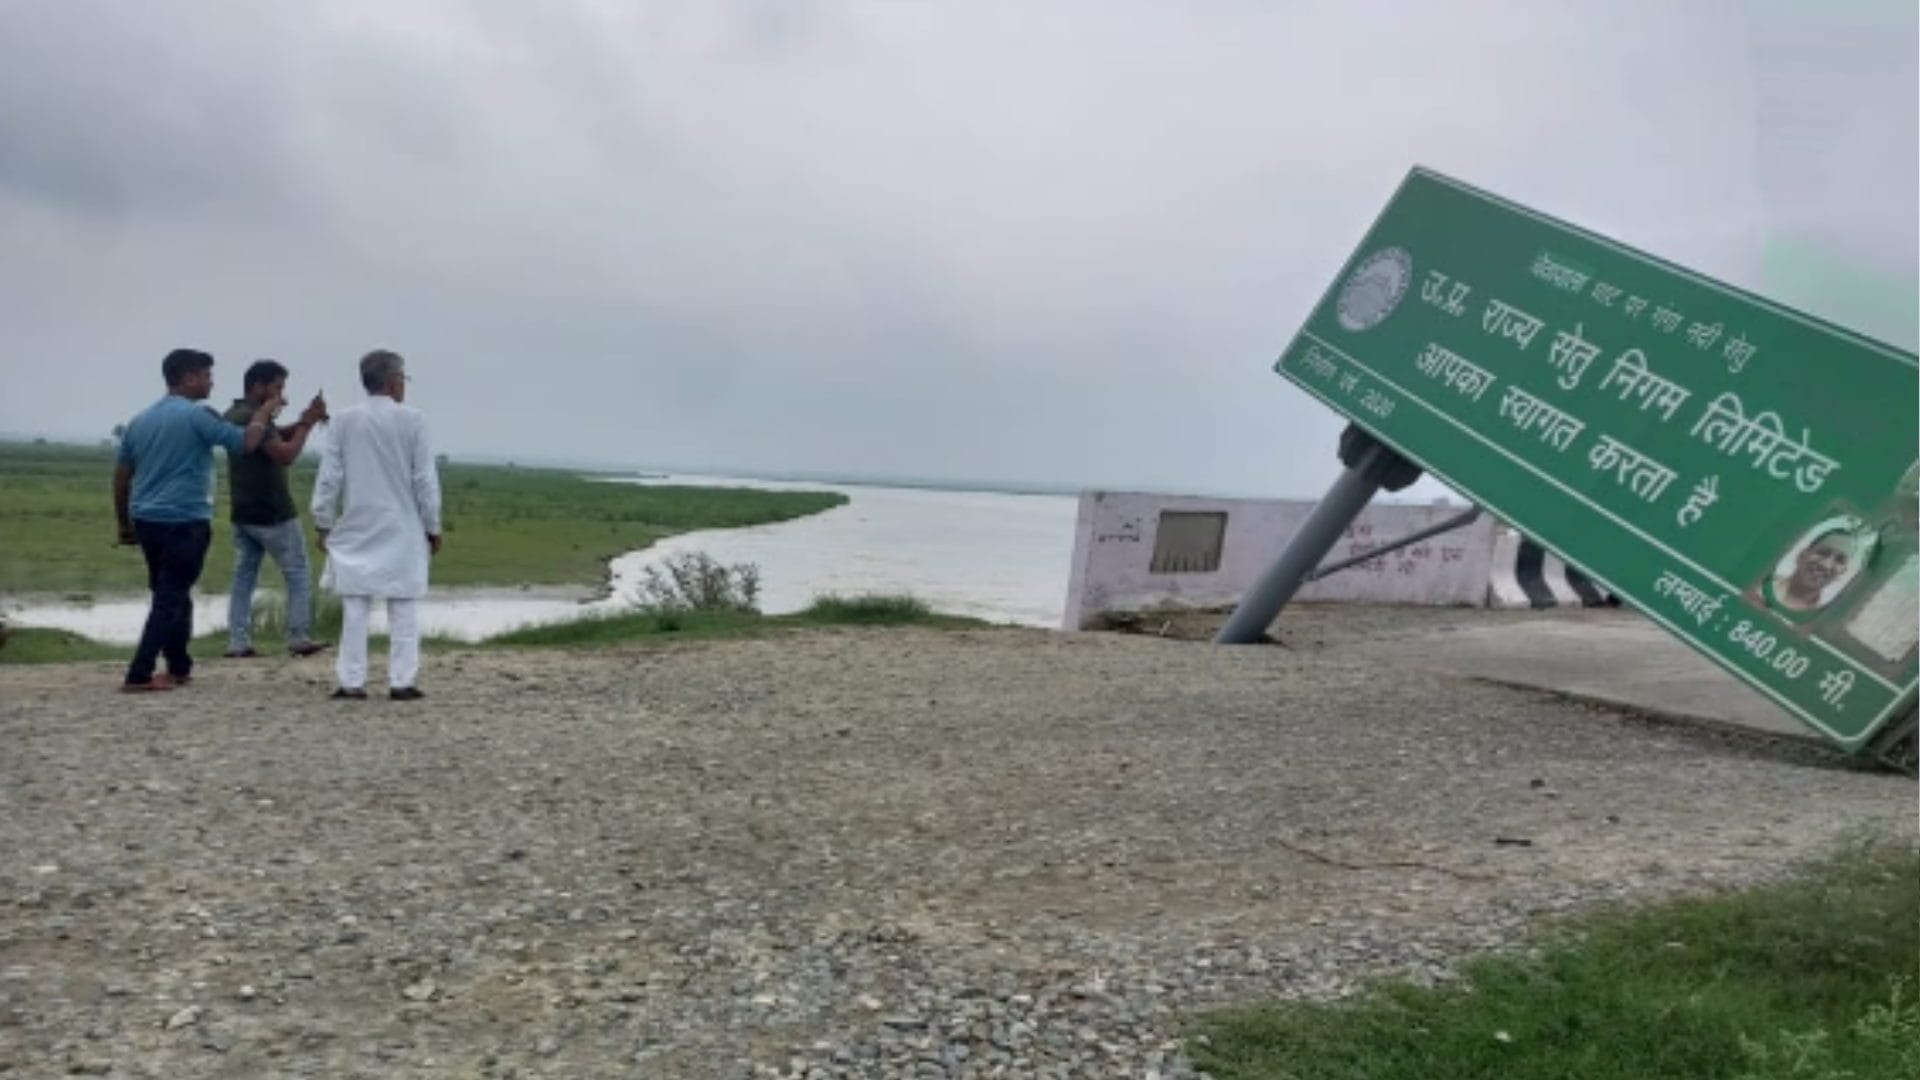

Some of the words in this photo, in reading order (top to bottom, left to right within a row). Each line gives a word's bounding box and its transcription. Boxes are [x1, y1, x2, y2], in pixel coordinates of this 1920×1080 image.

[1416, 342, 1498, 402] आपका
[1499, 384, 1587, 451] स्वागत
[1587, 433, 1679, 503] करता
[1675, 474, 1720, 528] है
[1482, 298, 1546, 351] राज्य
[1548, 322, 1602, 390] सेतु
[1598, 348, 1693, 422] निगम
[1690, 391, 1841, 493] लिमिटेड
[1728, 620, 1810, 679] 840.00
